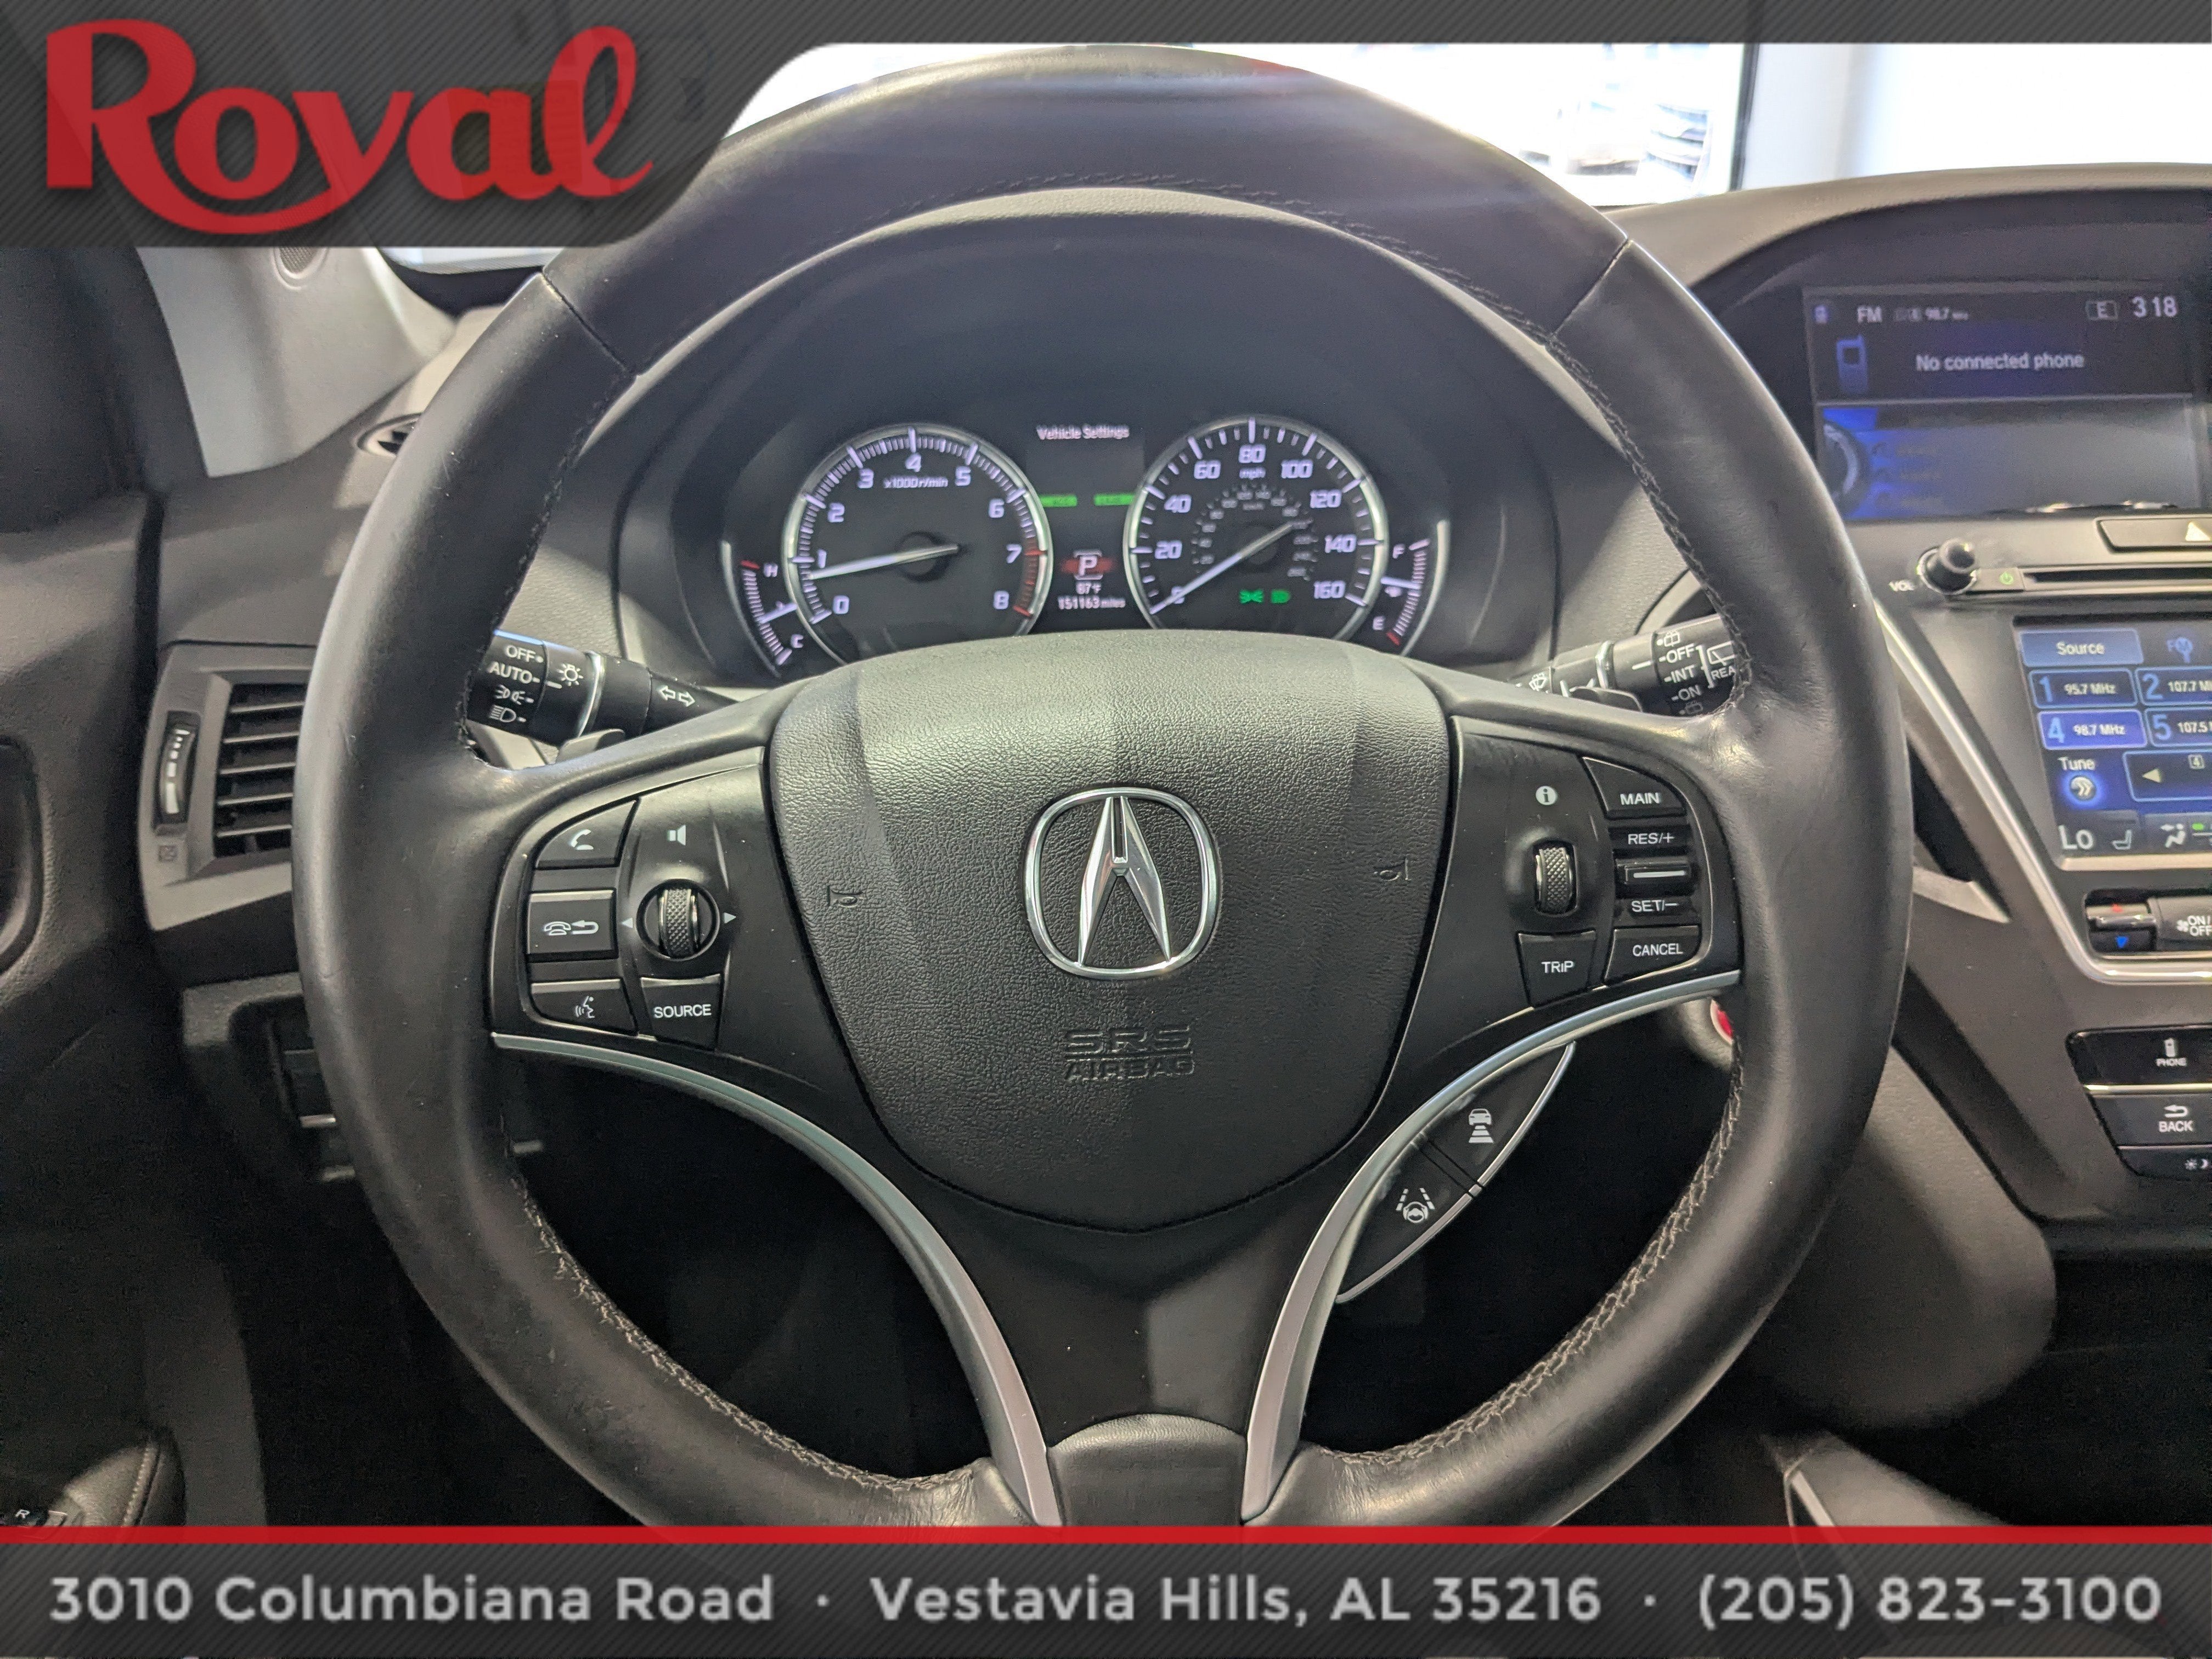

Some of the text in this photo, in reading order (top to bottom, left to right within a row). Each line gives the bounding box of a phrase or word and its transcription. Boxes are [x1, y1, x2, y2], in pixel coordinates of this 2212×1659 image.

[1857, 305, 1882, 323] FM
[1916, 353, 2085, 371] No connected phone
[1036, 423, 1130, 439] Vehicle Settings
[1239, 444, 1266, 463] 80
[905, 454, 921, 472] 4
[1194, 460, 1221, 479] 60
[1281, 460, 1313, 479] 100
[857, 470, 874, 488] 3
[955, 466, 971, 486] 5
[1239, 467, 1266, 480] mph
[989, 499, 1005, 518] 6
[1164, 495, 1192, 514] 40
[1310, 490, 1342, 509] 120
[828, 503, 845, 523] 2
[1155, 541, 1183, 560] 20
[1324, 534, 1357, 553] 140
[1392, 545, 1406, 558] F
[816, 549, 827, 568] 1
[1007, 545, 1022, 563] 7
[763, 563, 778, 577] H
[1079, 555, 1098, 575] P
[1313, 580, 1345, 599] 160
[833, 595, 850, 614] 0
[993, 591, 1009, 610] 8
[1373, 616, 1386, 631] E
[791, 634, 804, 648] C
[2056, 641, 2106, 656] Source
[505, 645, 536, 662] OFF
[1666, 643, 1695, 663] OFF
[487, 661, 533, 684] AUTO
[1671, 664, 1695, 683] INT
[1711, 665, 1736, 680] REA
[1679, 685, 1701, 701] ON
[2039, 675, 2053, 703] 1
[2064, 682, 2117, 695] 95.7 MHz
[2142, 673, 2163, 700] 2
[2169, 680, 2196, 692] 107.7
[2048, 717, 2064, 743] 4
[2073, 723, 2126, 736] 98.7 MHz
[2153, 714, 2172, 740] 5
[2178, 721, 2208, 733] 107.5
[2058, 757, 2096, 771] Tune
[1620, 792, 1661, 805] MAIN
[1628, 832, 1674, 845] RES/+
[2190, 925, 2212, 936] OFF
[1633, 943, 1683, 957] CANCEL
[1542, 960, 1575, 973] TRIP
[654, 1004, 712, 1018] SOURCE
[1065, 1026, 1193, 1054] SRS
[1065, 1059, 1195, 1082] AIRBAG
[2156, 1058, 2187, 1067] PHONE
[2159, 1120, 2193, 1133] BACK
[15, 1509, 30, 1519] R
